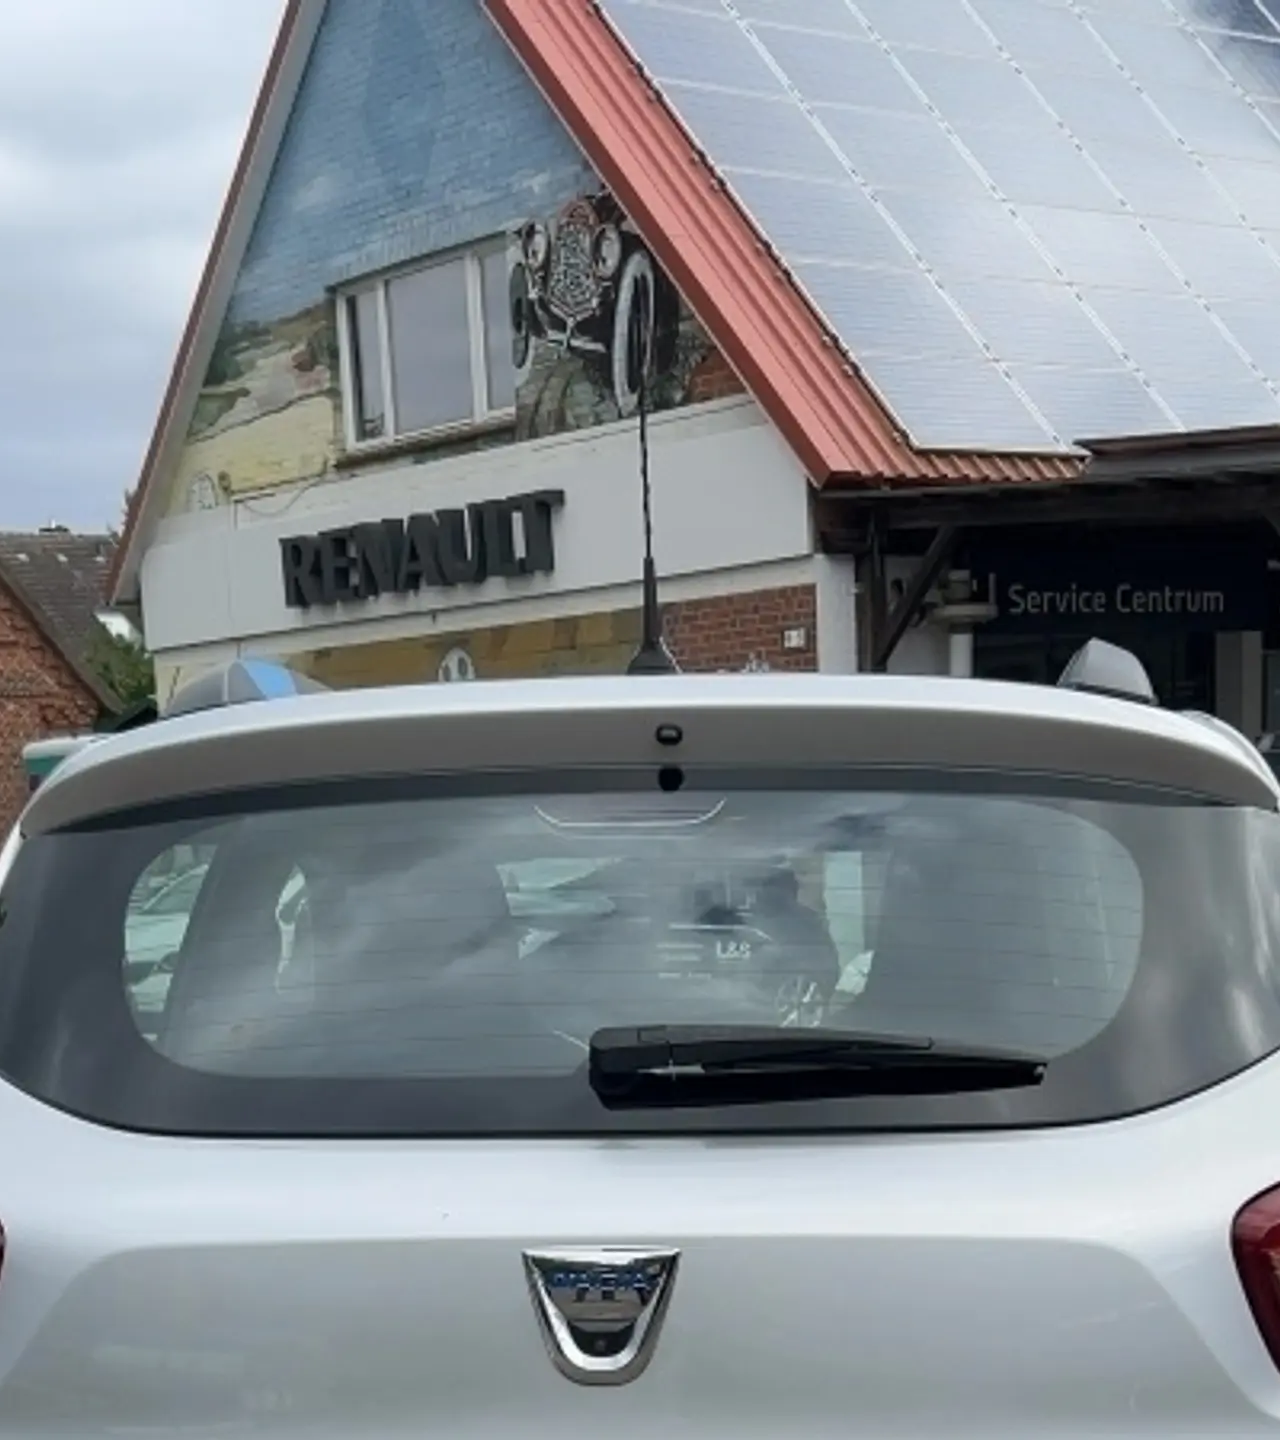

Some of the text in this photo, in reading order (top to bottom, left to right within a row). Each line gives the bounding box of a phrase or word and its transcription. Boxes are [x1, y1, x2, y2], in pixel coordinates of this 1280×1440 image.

[280, 489, 565, 608] RENAULT
[1008, 582, 1224, 614] Service Centrum
